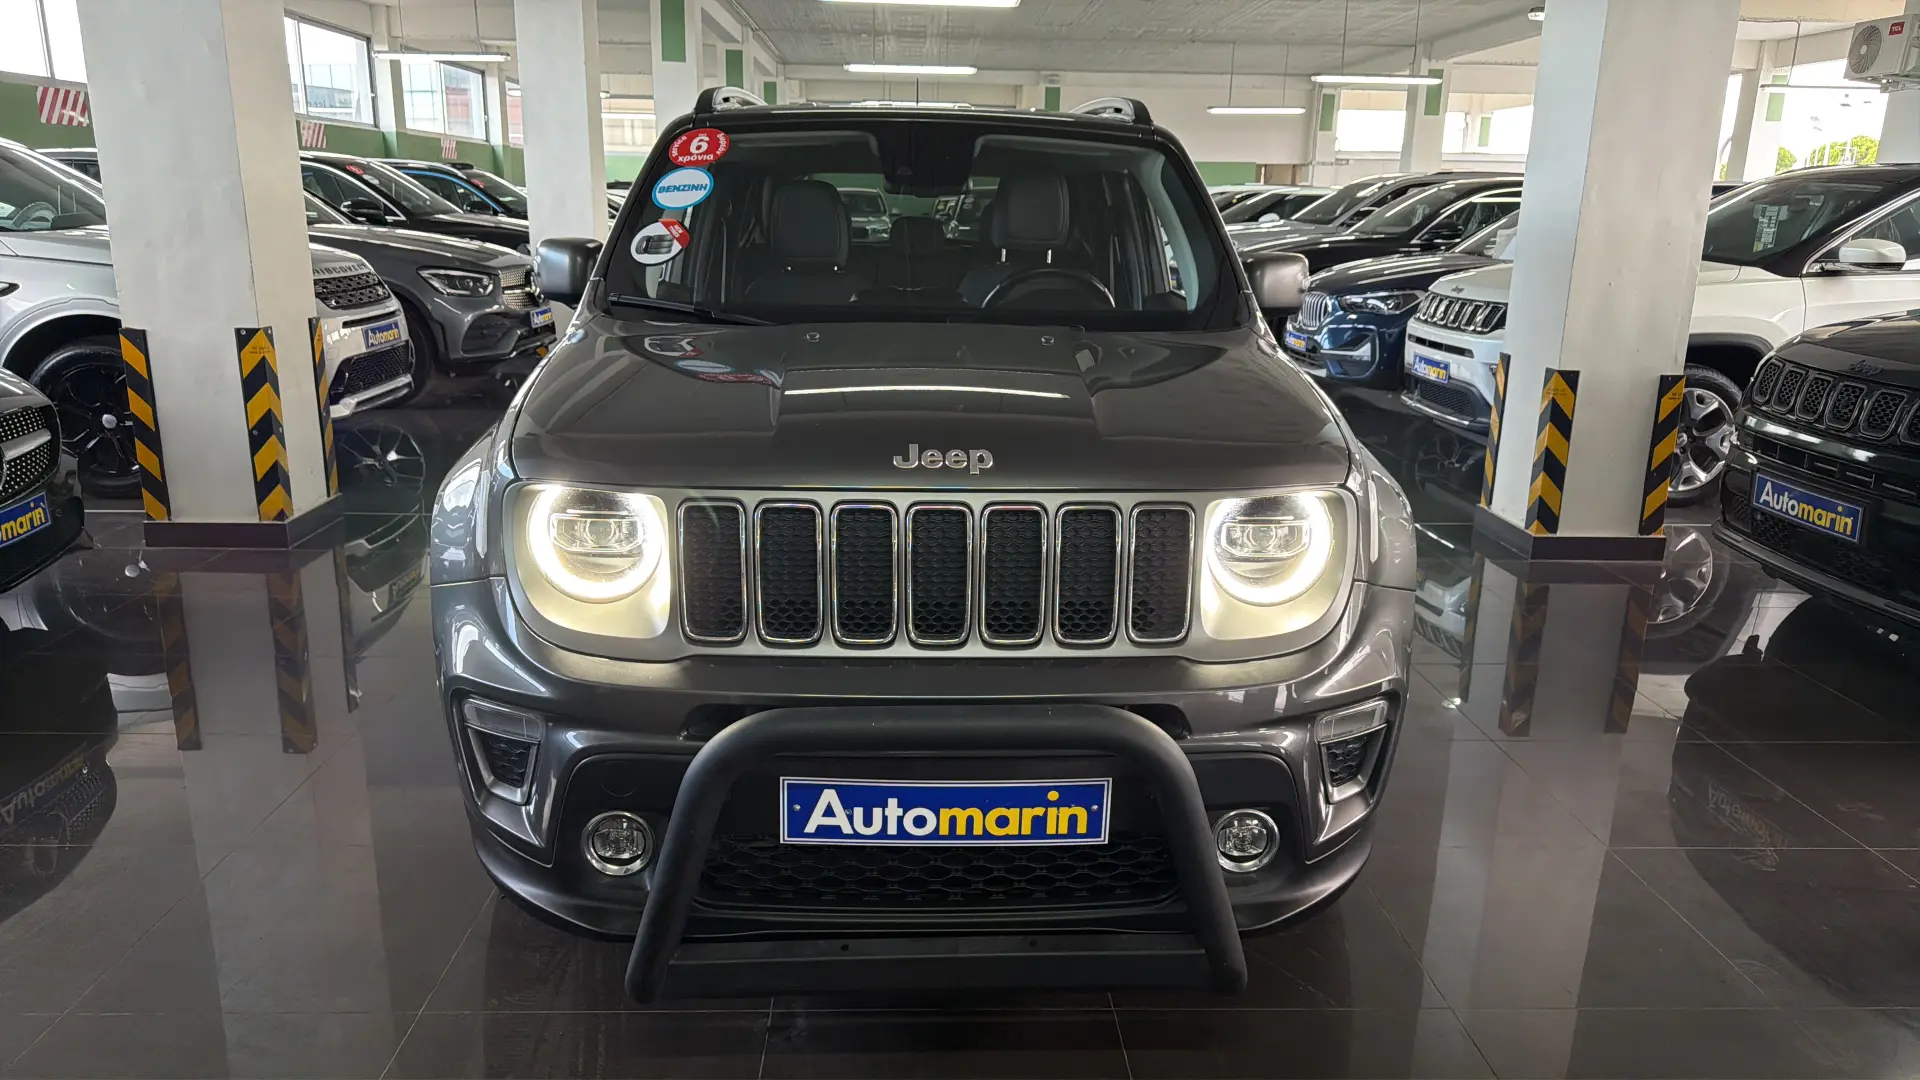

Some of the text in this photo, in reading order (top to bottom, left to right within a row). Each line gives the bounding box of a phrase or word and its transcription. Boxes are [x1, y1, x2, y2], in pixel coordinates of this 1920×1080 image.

[677, 154, 714, 163] χρόνια
[690, 136, 709, 154] 6
[893, 443, 994, 475] Jeep
[0, 501, 46, 541] marin
[1760, 481, 1853, 536] Automarin
[804, 789, 1088, 837] Automarin
